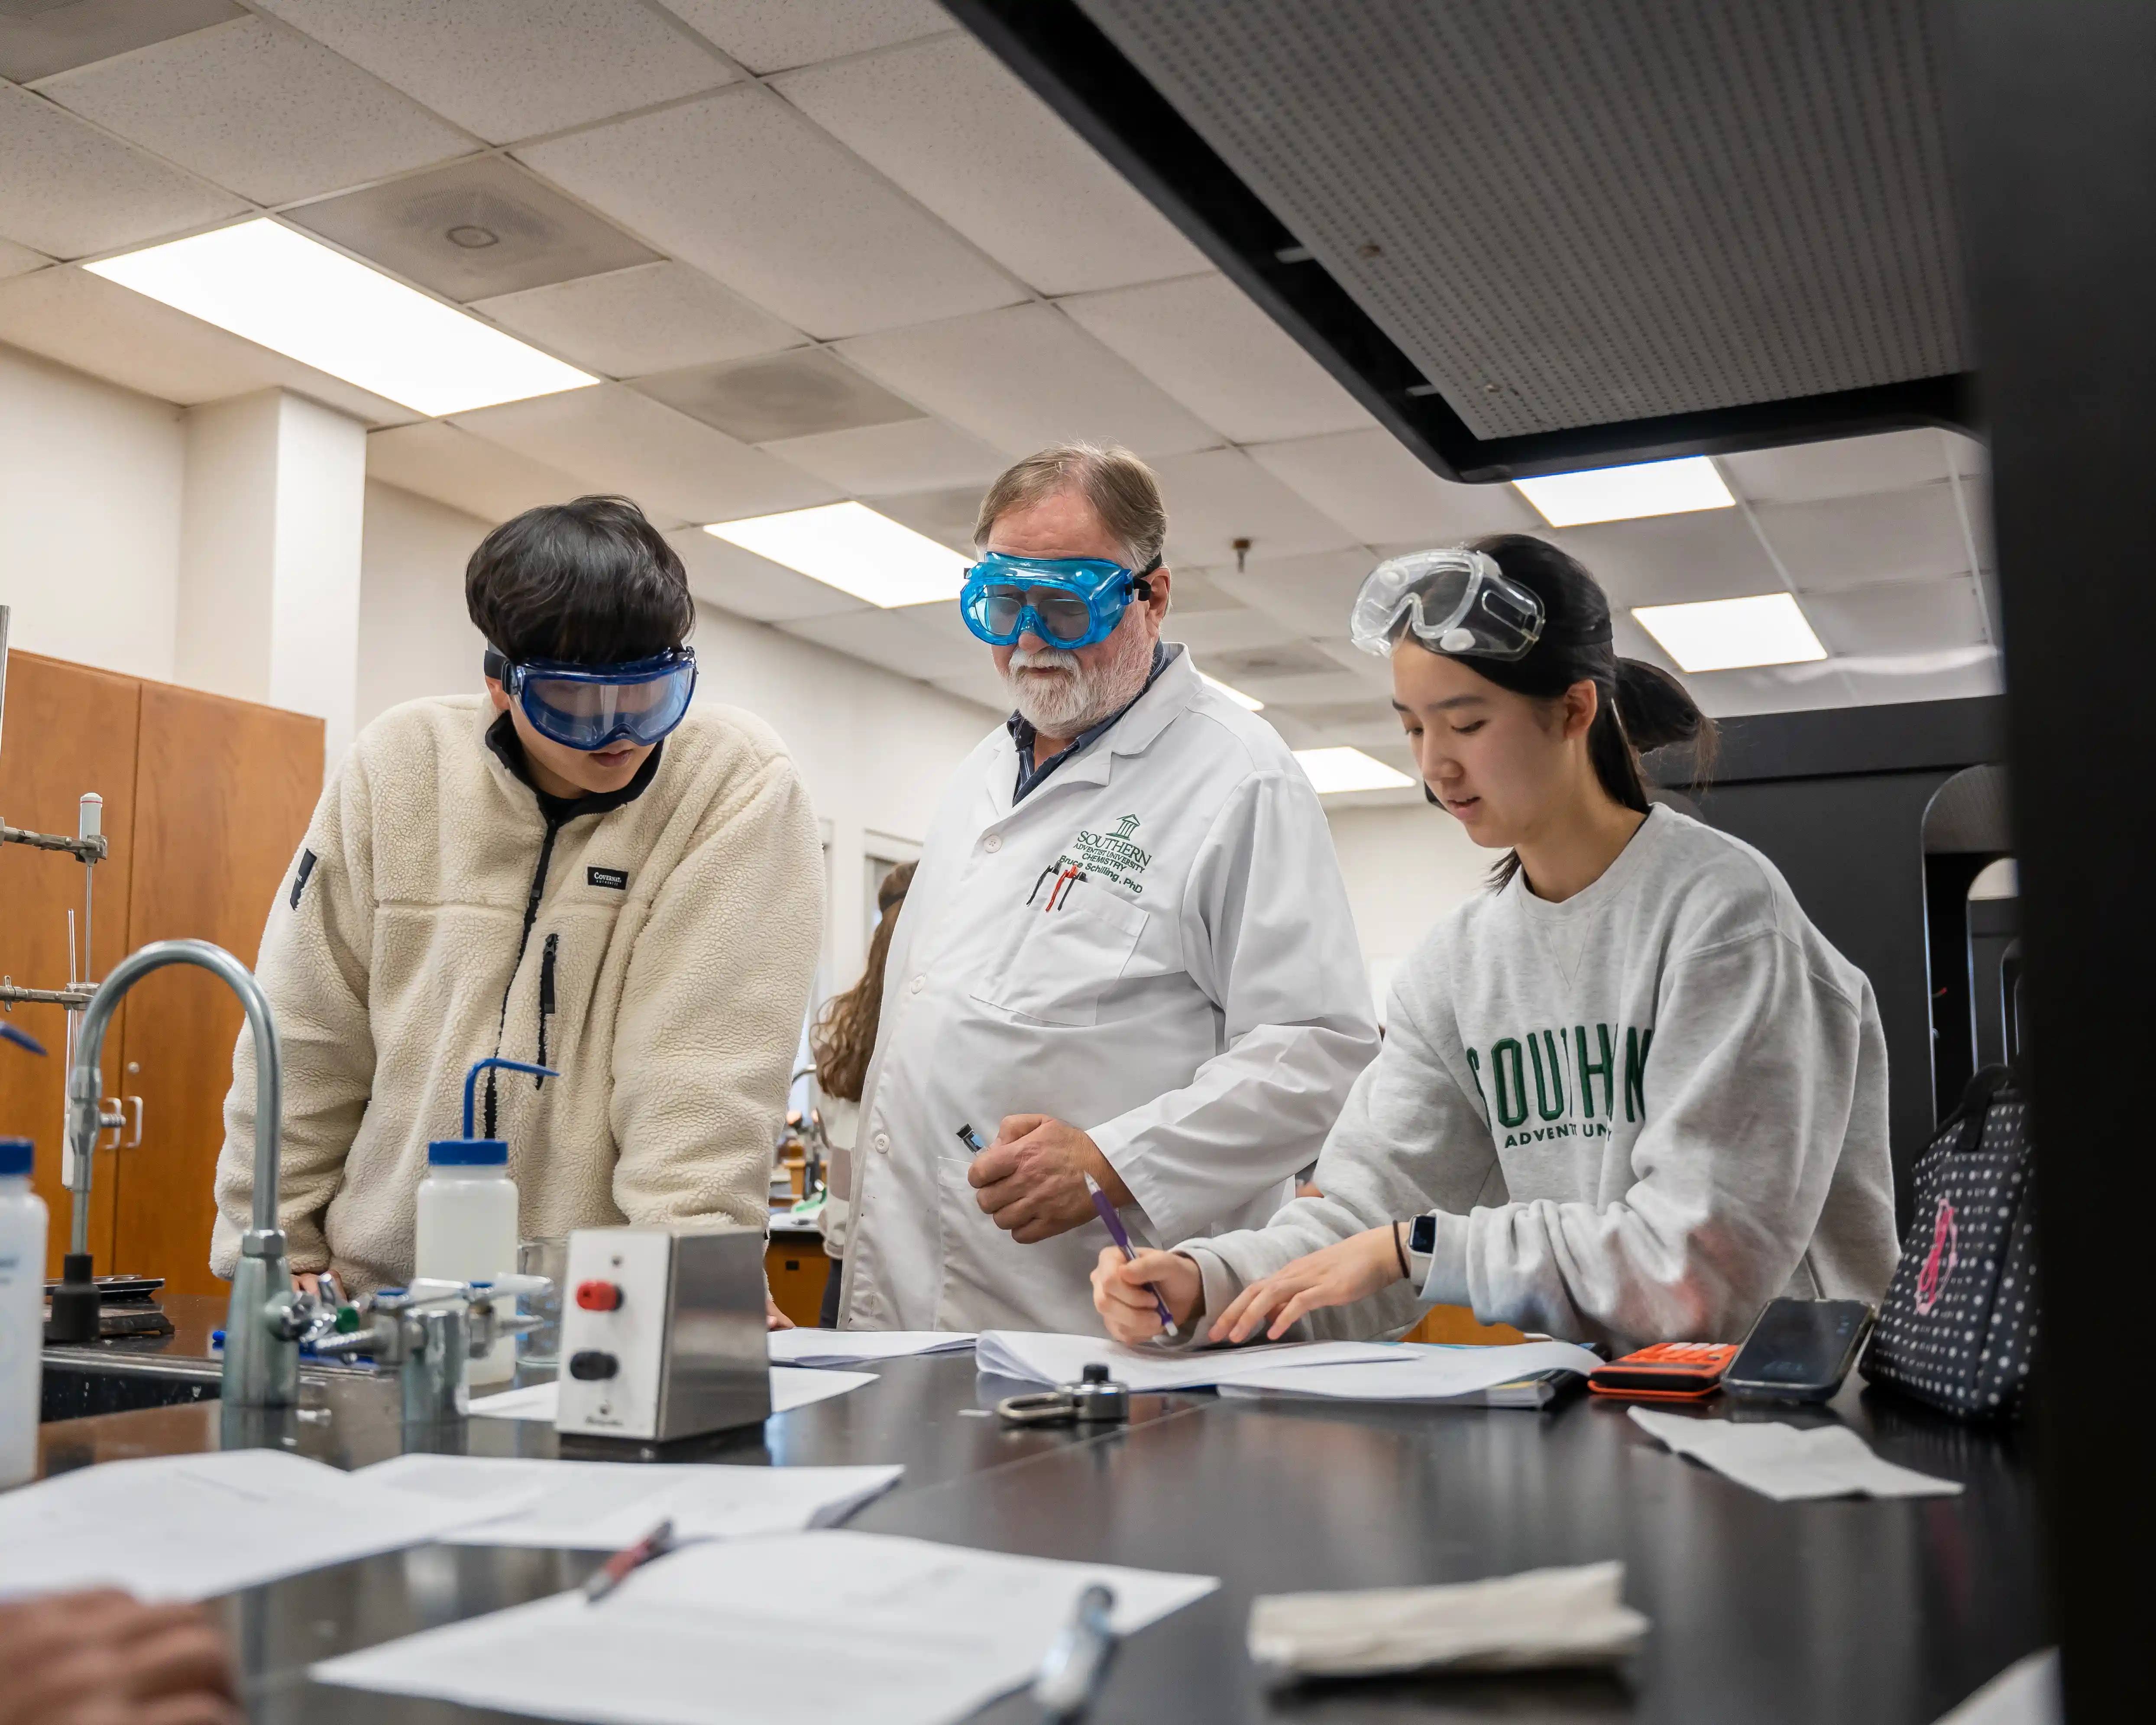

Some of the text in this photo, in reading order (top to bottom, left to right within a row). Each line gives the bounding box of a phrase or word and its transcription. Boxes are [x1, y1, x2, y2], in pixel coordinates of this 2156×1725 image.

[1073, 843, 1146, 873] ADVENTIST UNIVERSITY
[1077, 830, 1152, 867] SOUTHERN
[1082, 853, 1127, 872] CHEMISTRY
[1059, 855, 1084, 868] Bruce
[1123, 877, 1143, 893] PhD
